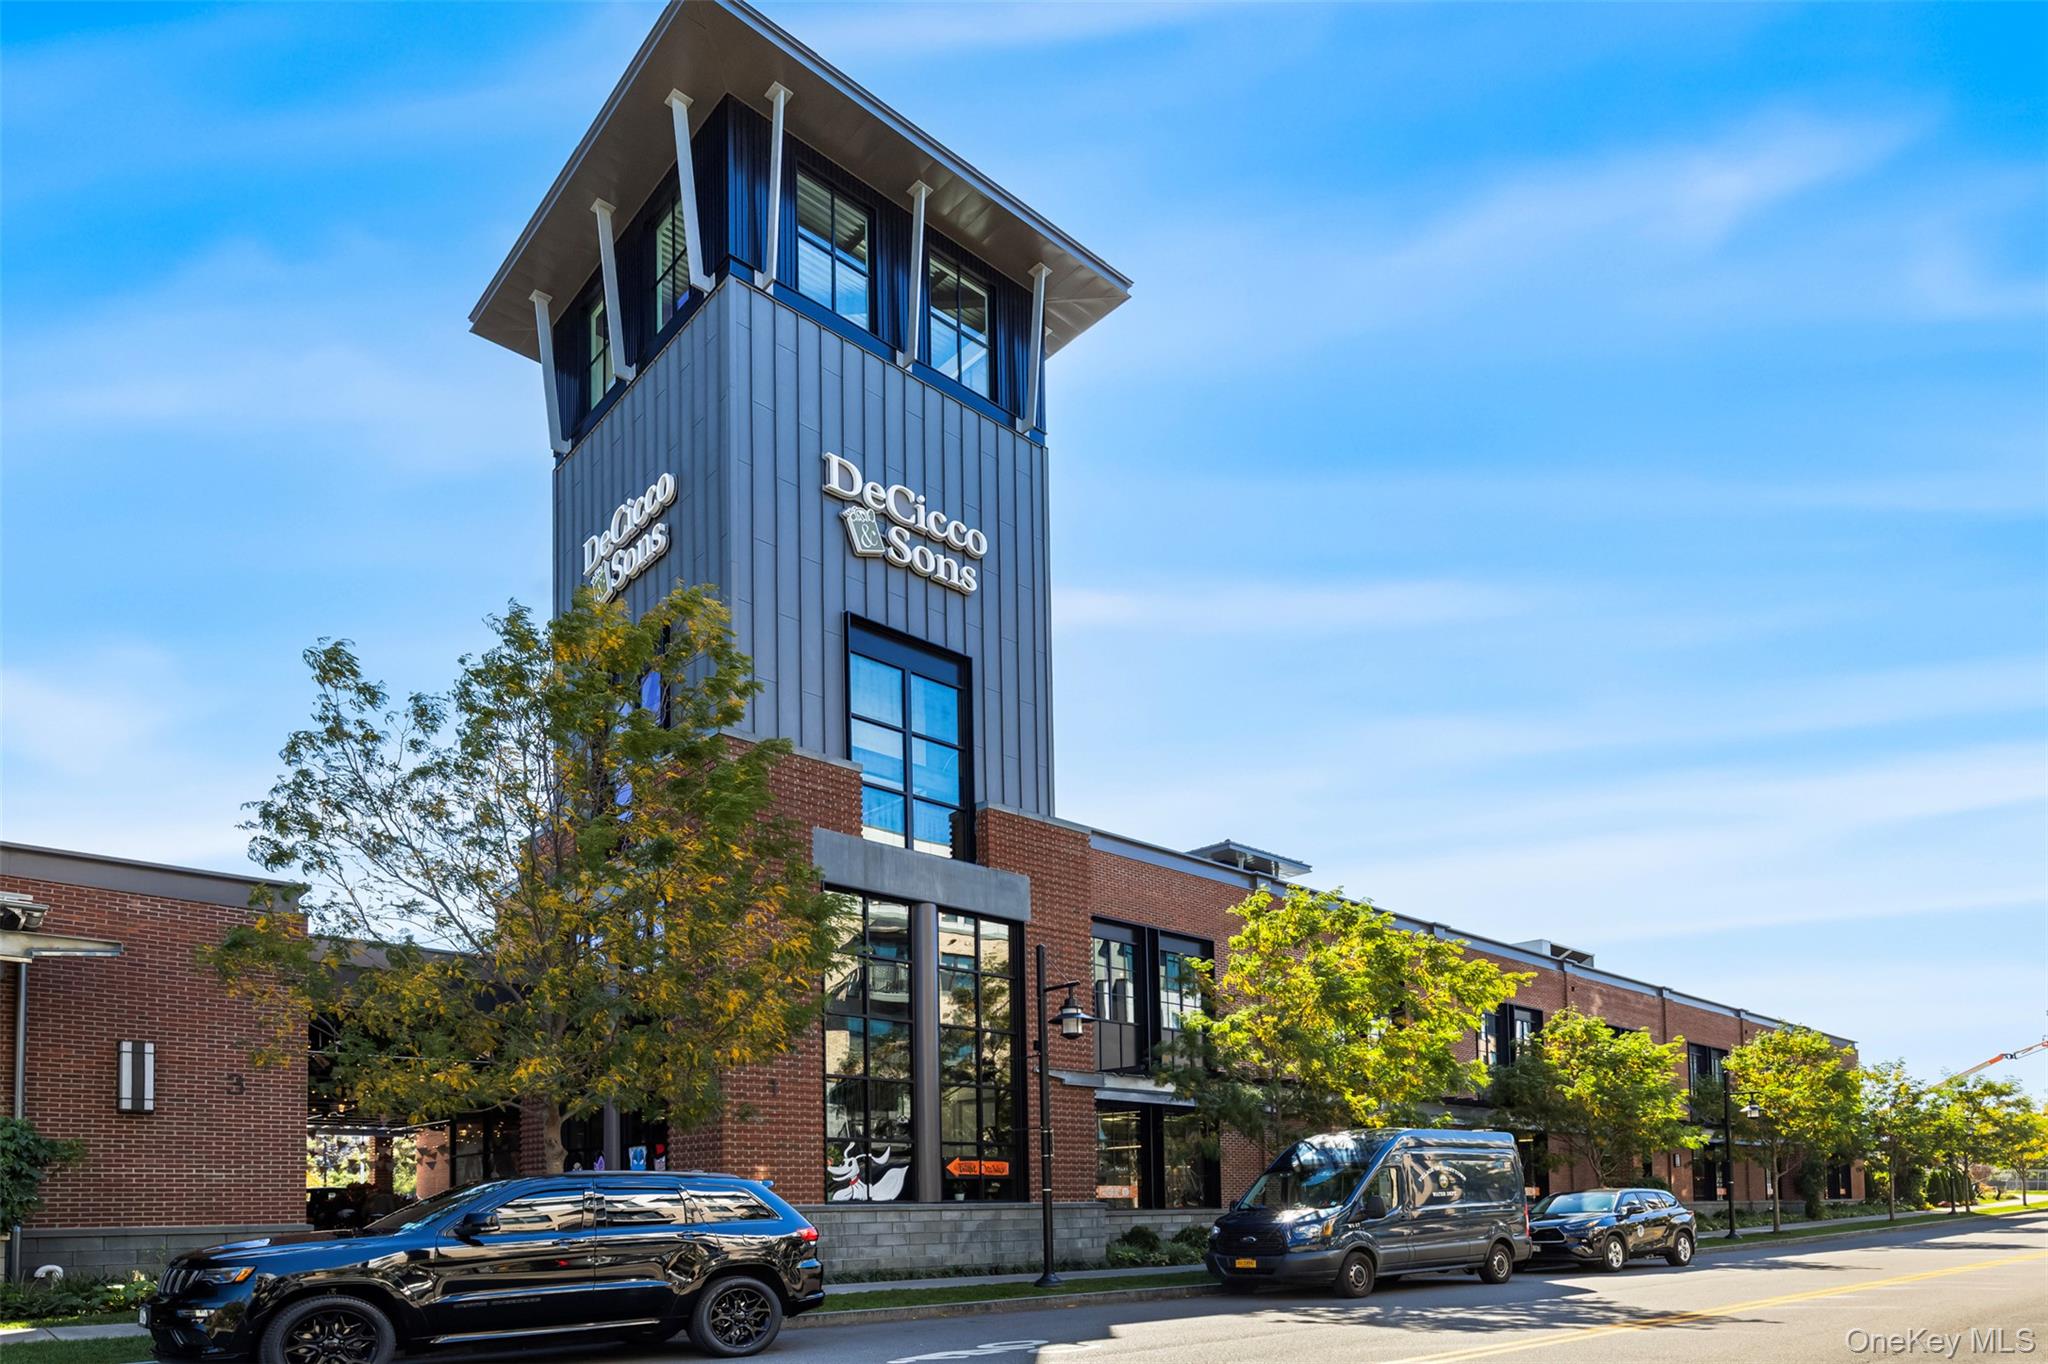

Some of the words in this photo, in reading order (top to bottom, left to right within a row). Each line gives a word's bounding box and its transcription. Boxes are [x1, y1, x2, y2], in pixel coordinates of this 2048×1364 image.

[583, 472, 677, 578] DeCicco
[822, 452, 988, 559] DeCicco
[611, 522, 670, 591] Sons
[860, 523, 879, 548] &
[886, 525, 978, 595] Sons
